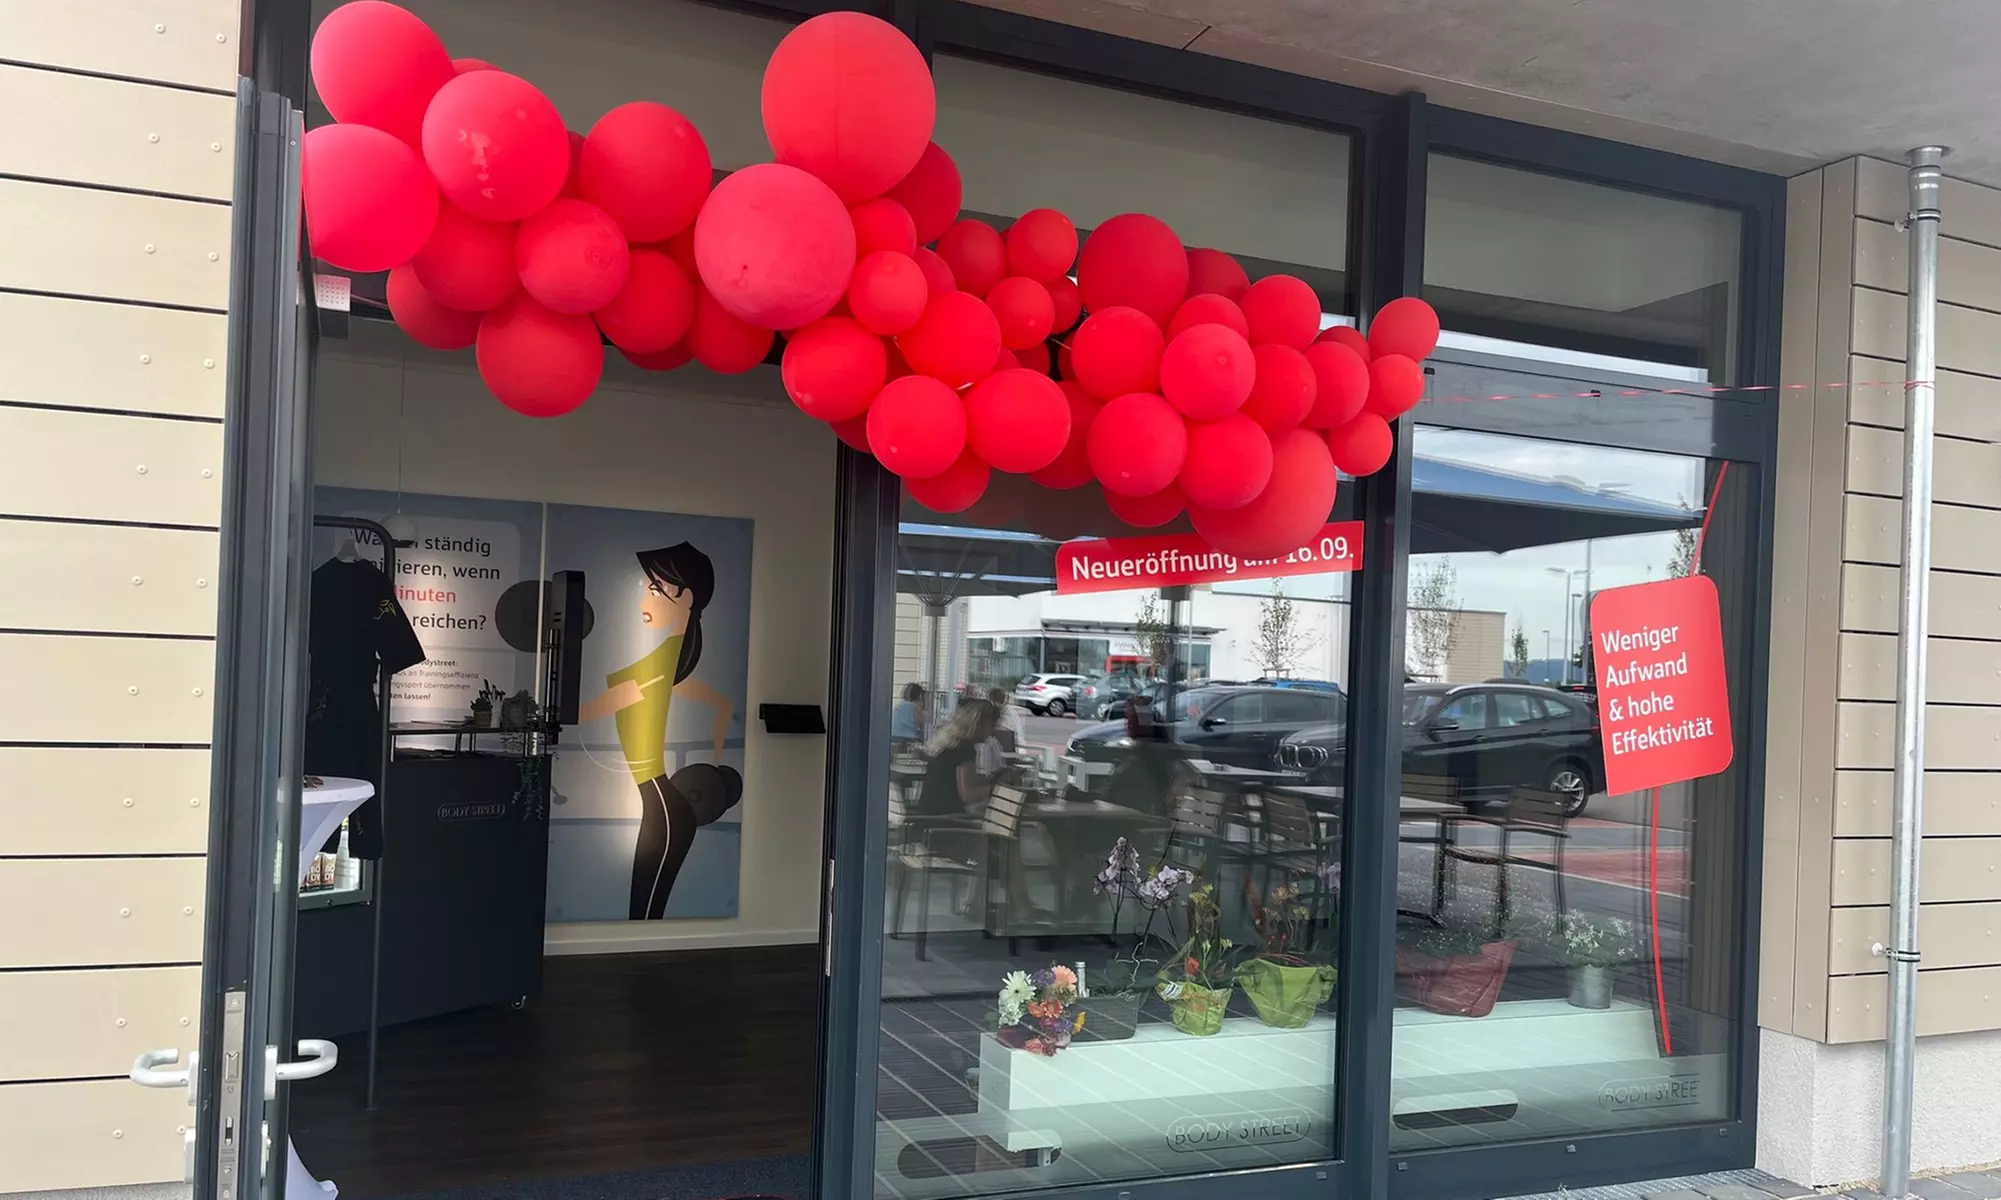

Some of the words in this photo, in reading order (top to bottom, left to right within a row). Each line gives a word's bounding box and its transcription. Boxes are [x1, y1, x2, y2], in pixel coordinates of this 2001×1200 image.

[424, 537, 491, 558] ständig
[453, 566, 500, 580] wenn
[1072, 549, 1238, 581] Neueröffnung
[393, 585, 457, 603] inuten
[412, 613, 487, 630] reichen?
[1601, 625, 1679, 654] Weniger
[1605, 652, 1688, 688] Aufwand
[1609, 698, 1624, 723] &
[1628, 691, 1675, 718] hohe
[1612, 716, 1715, 756] Effektivität
[1605, 1085, 1650, 1104] BODY
[1655, 1080, 1700, 1101] STREE
[1175, 1121, 1234, 1145] BODY
[1239, 1115, 1300, 1140] STREET
